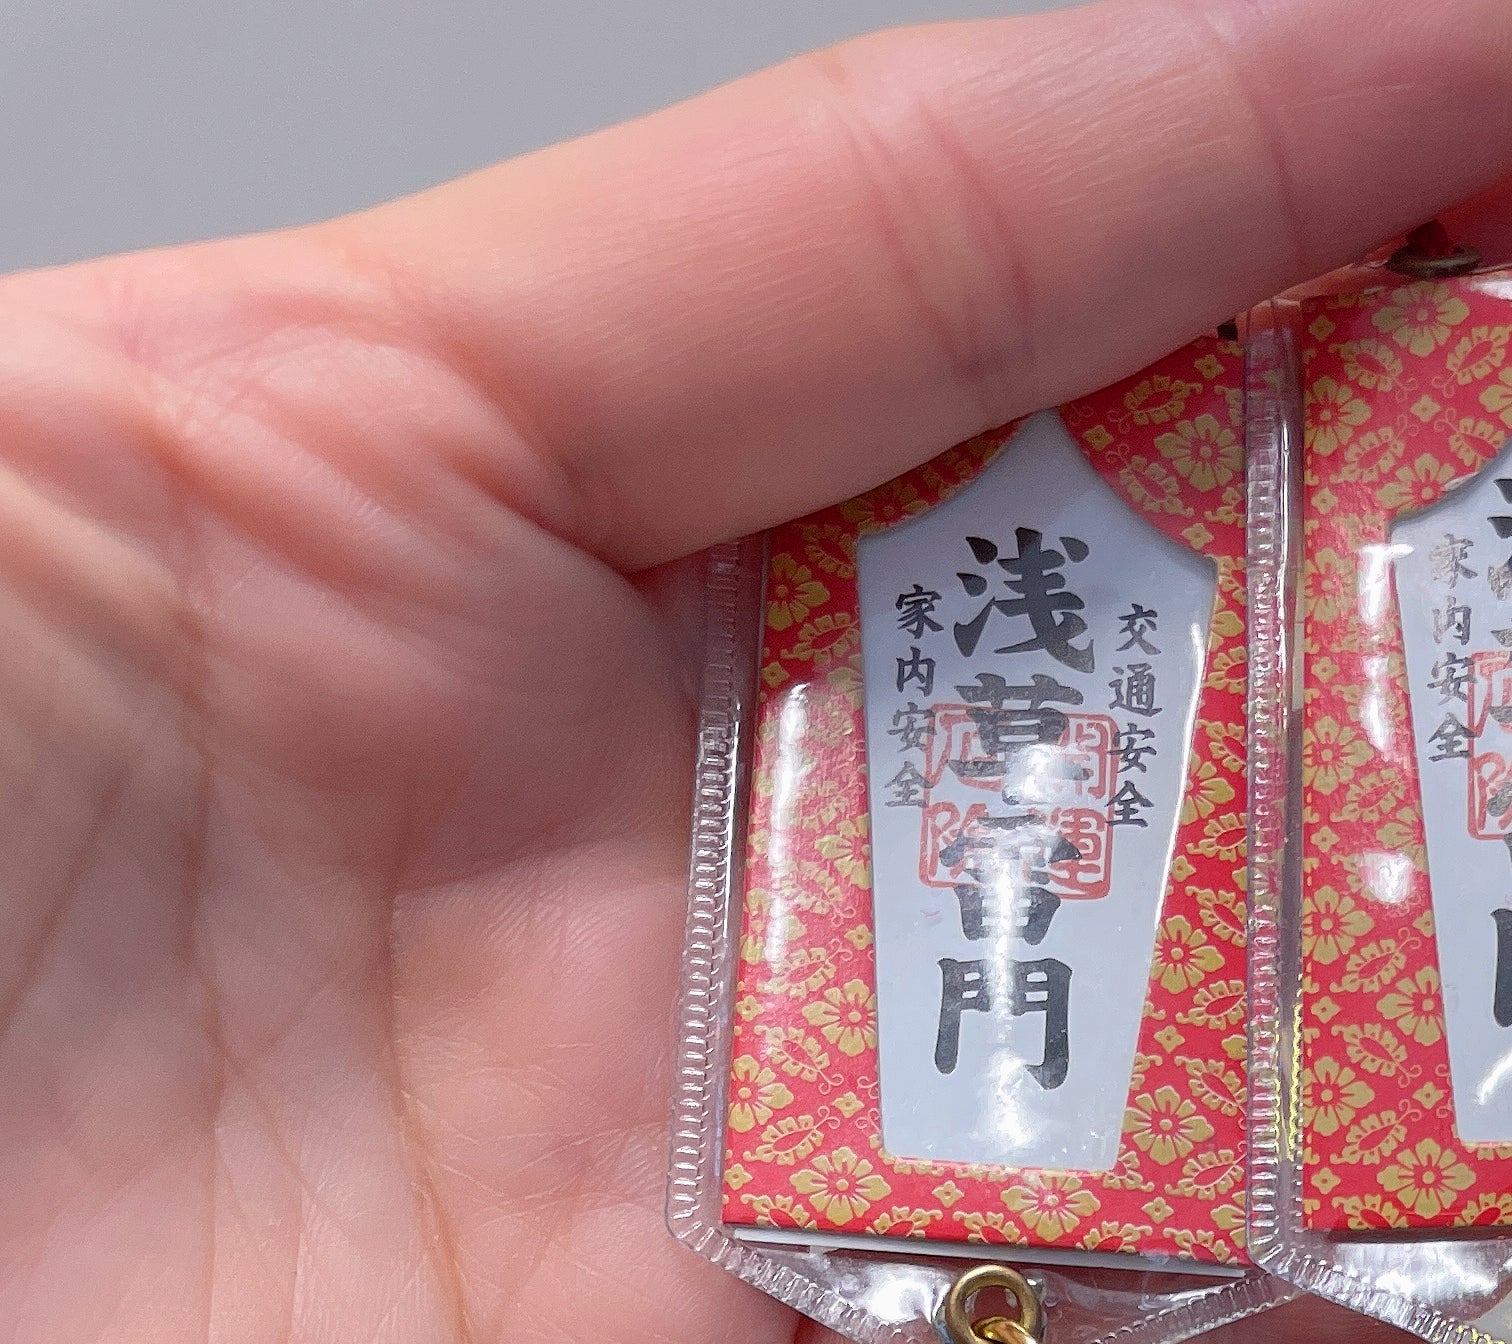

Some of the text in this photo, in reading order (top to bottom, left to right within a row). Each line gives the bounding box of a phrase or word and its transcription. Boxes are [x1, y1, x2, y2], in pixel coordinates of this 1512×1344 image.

[884, 583, 945, 810] 家内安全
[1103, 602, 1164, 828] 交通安全
[1424, 531, 1477, 762] 家内安全
[935, 527, 1097, 1091] 浅草雷門
